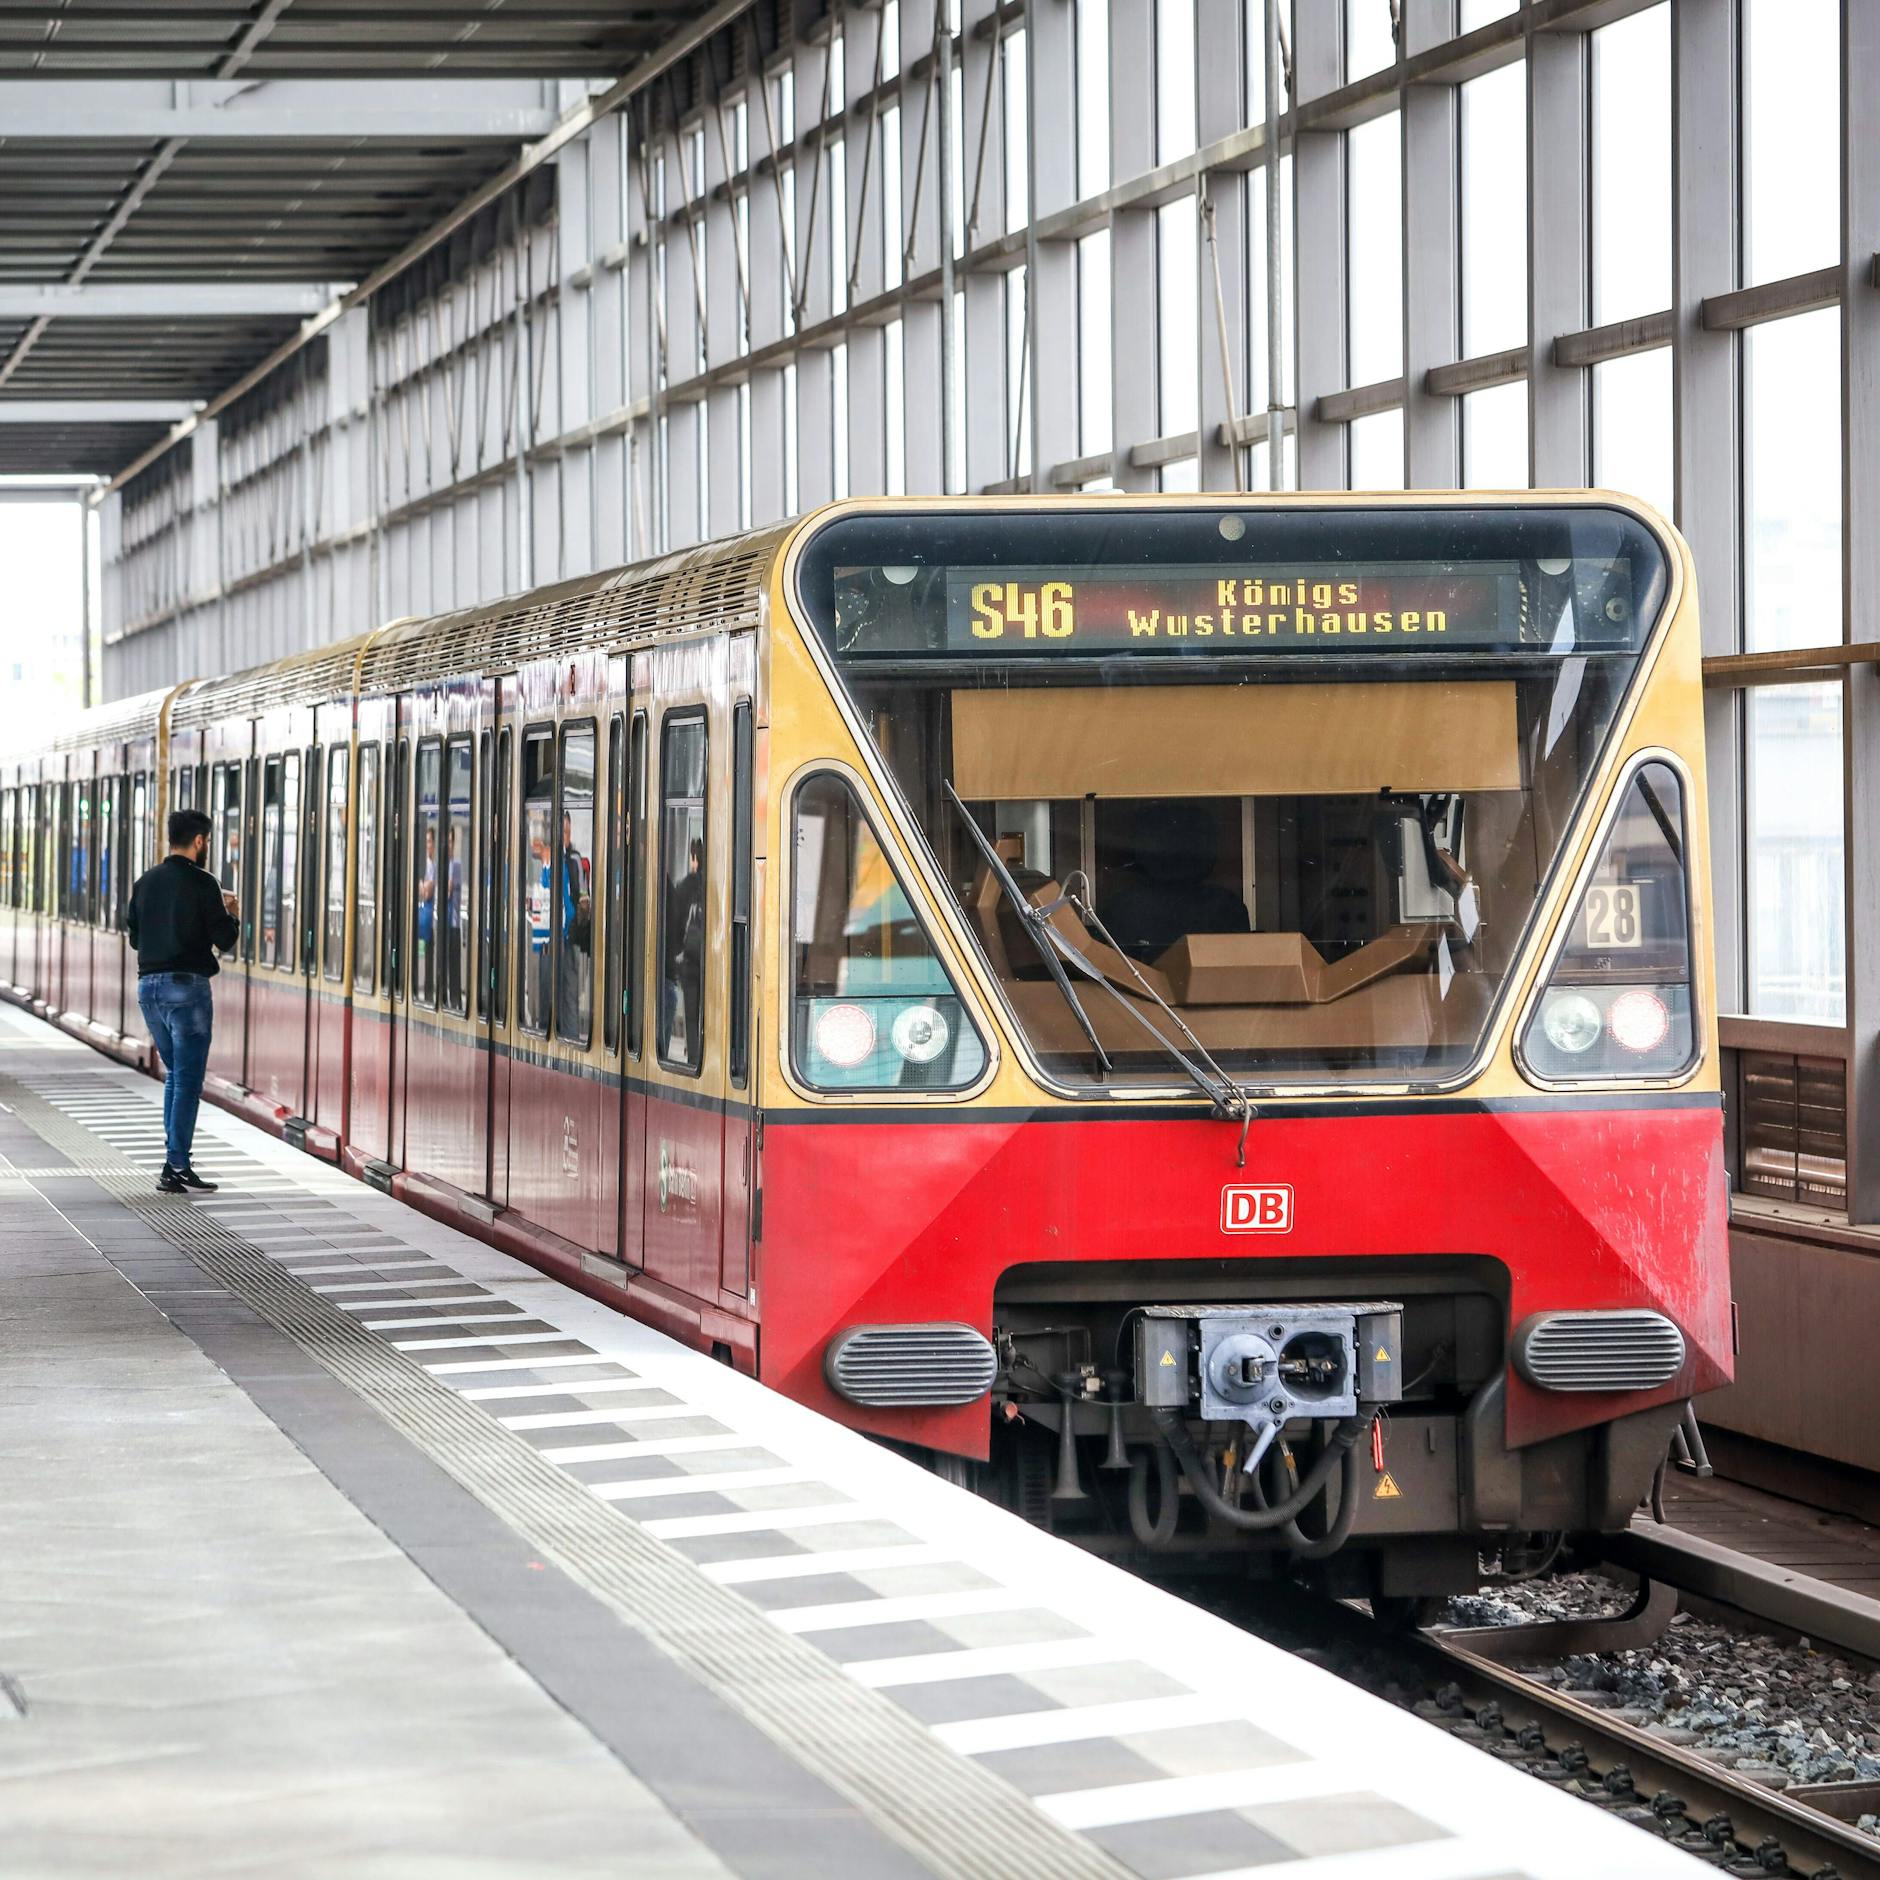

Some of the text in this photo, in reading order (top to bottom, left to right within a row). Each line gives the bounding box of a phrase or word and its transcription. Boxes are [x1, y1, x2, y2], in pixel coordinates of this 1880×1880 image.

[1217, 579, 1358, 609] Königs
[972, 582, 1074, 639] S46
[1127, 608, 1447, 636] Wusterhausen
[1588, 888, 1636, 943] 28
[1231, 1193, 1284, 1224] DB
